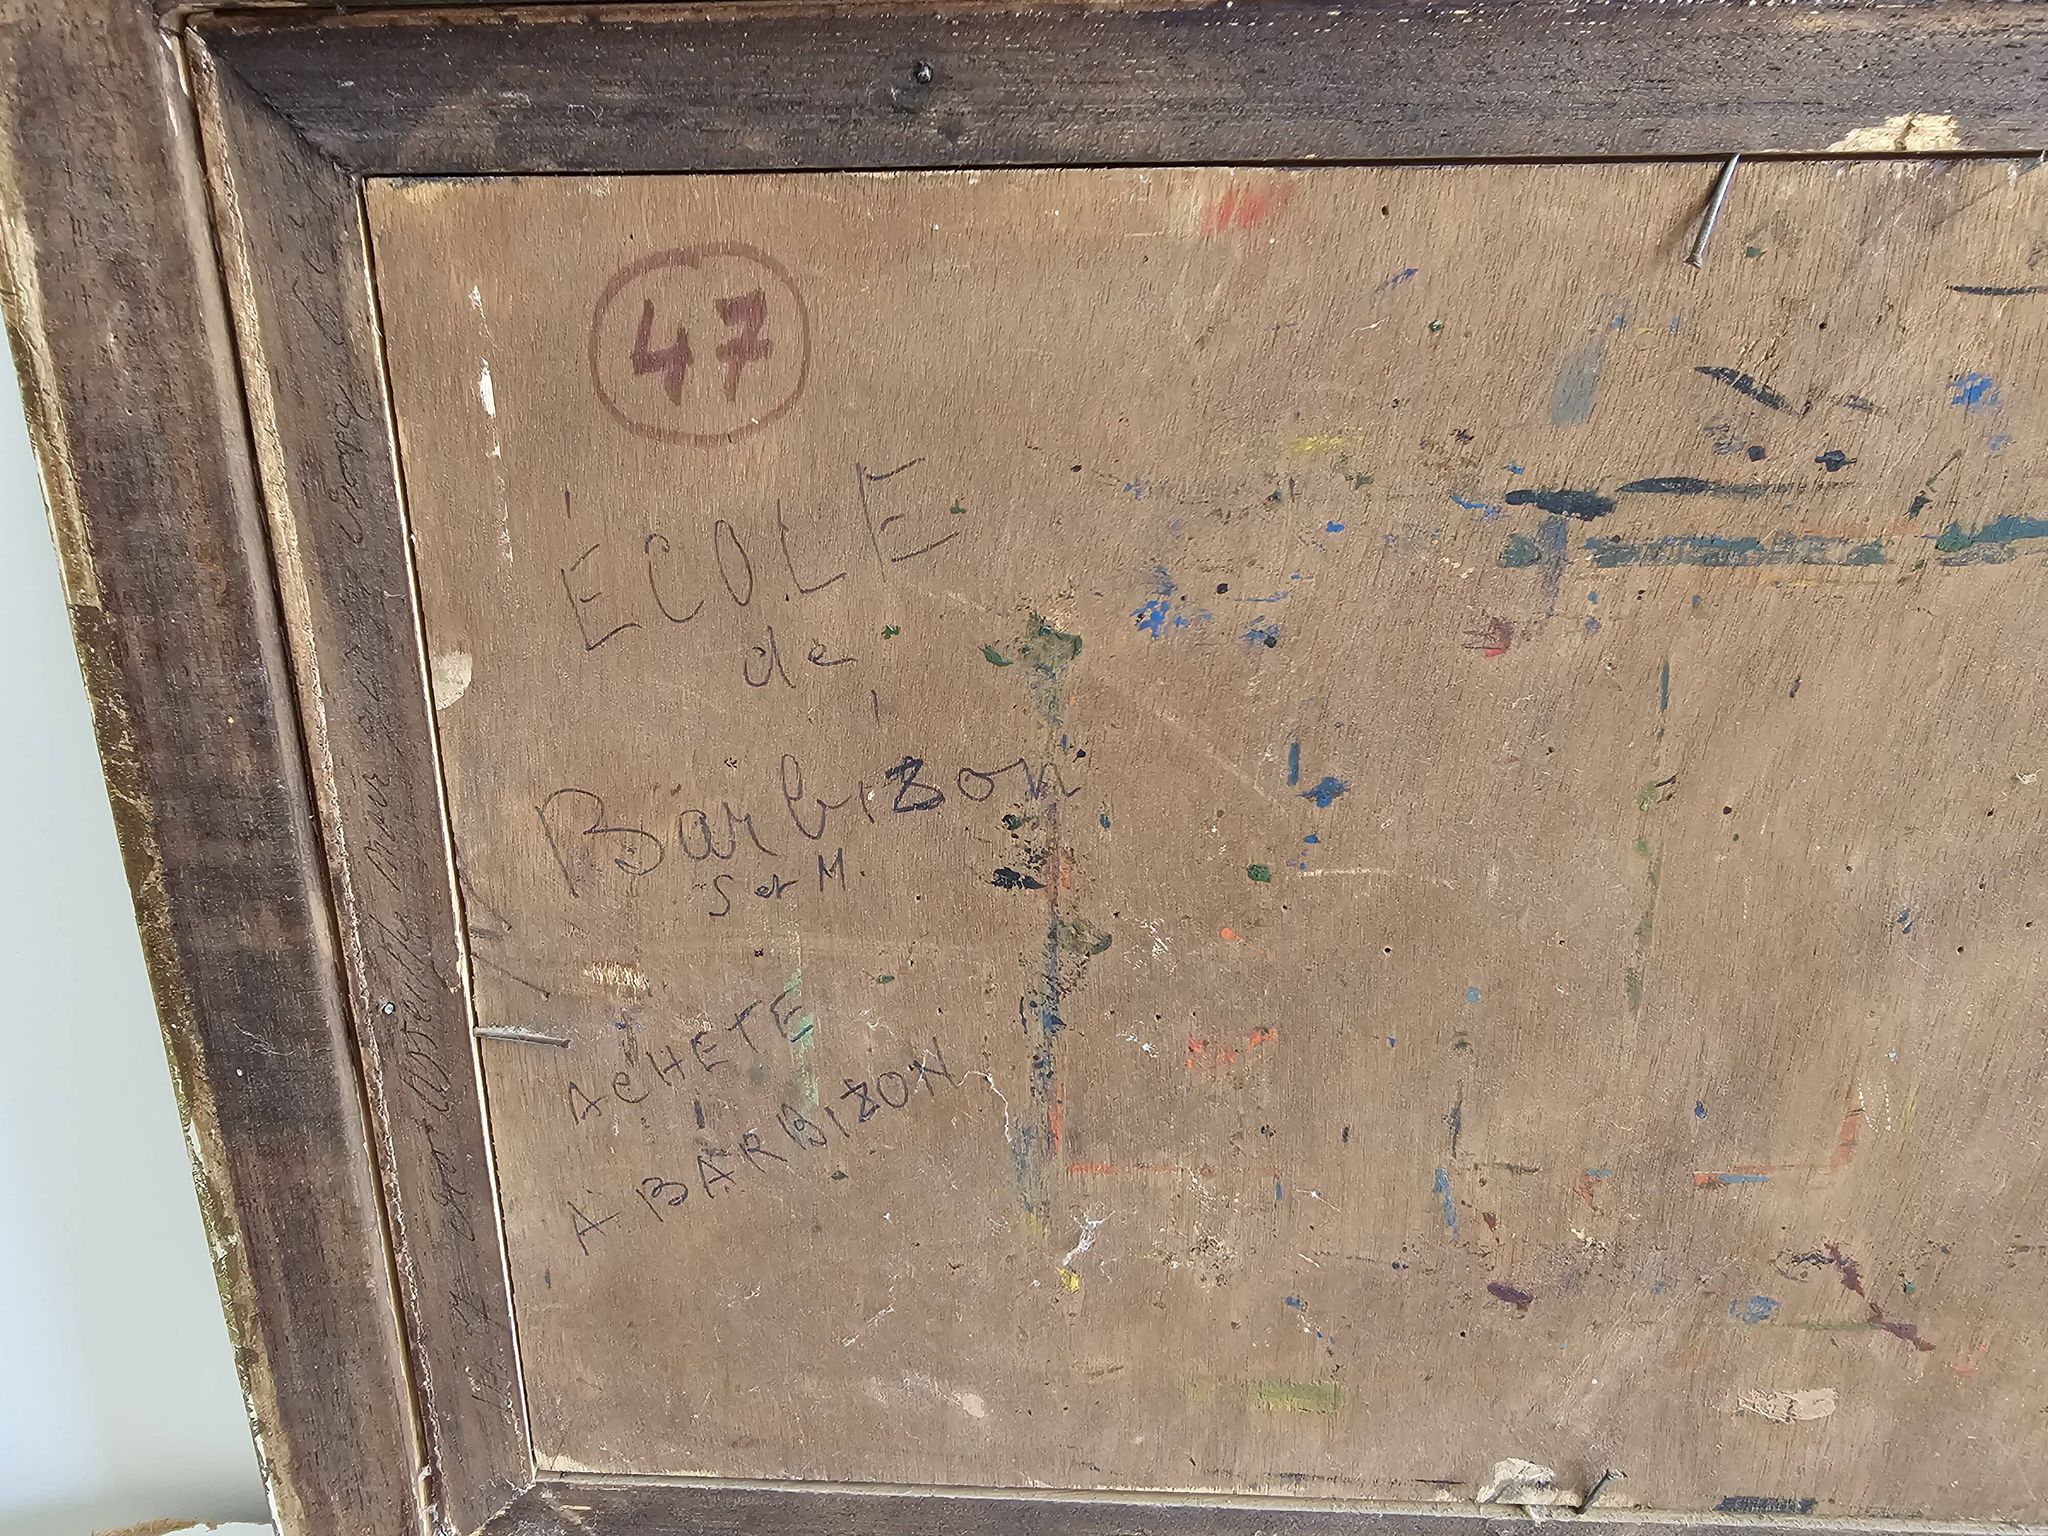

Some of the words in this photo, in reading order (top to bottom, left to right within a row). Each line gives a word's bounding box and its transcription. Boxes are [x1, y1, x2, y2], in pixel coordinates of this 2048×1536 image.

[632, 290, 770, 405] 47
[743, 624, 858, 689] de
[536, 753, 1081, 898] Barbizon
[708, 874, 735, 918] S
[567, 1200, 620, 1256] A
[635, 1036, 960, 1222] BARBIZON
